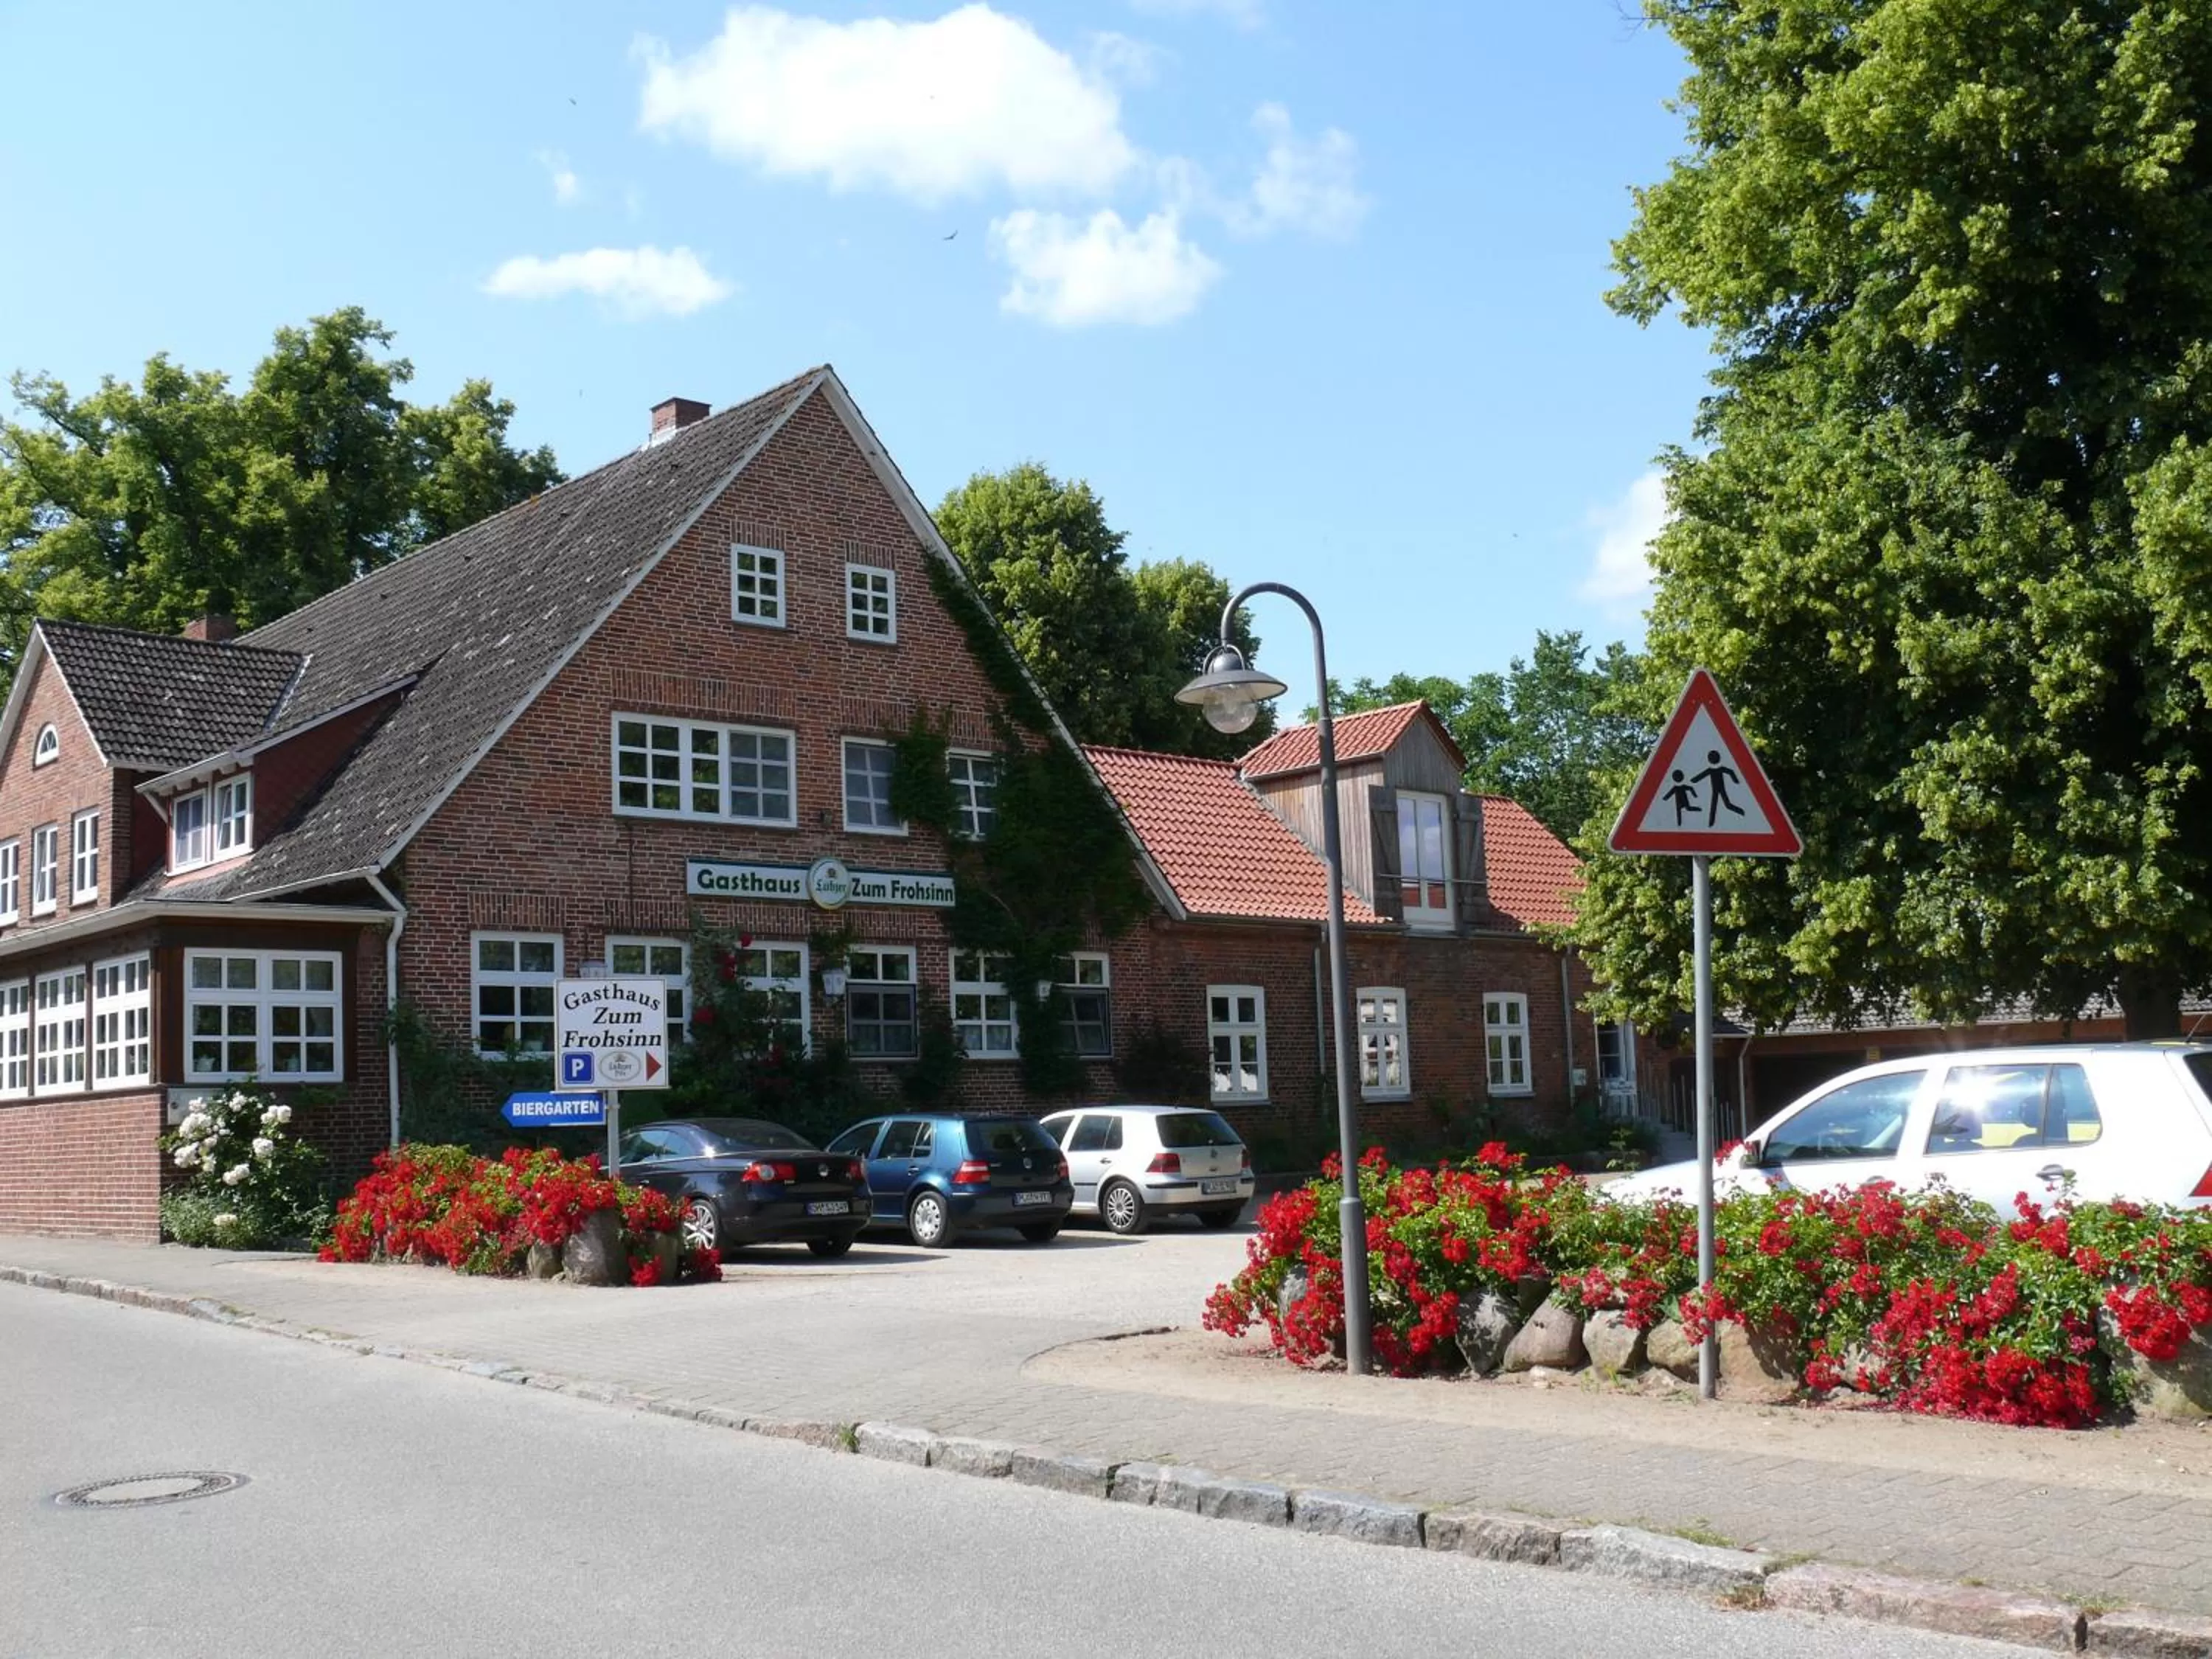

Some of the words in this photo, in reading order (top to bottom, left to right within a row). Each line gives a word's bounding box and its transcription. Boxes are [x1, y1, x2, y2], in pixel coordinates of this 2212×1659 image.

[697, 869, 800, 894] Gasthaus
[852, 878, 886, 897] Zum
[891, 880, 954, 902] Frohsinn
[564, 984, 661, 1011] Gasthaus
[593, 1007, 642, 1024] Zum
[563, 1029, 661, 1047] Frohsinn
[571, 1058, 585, 1077] P
[512, 1100, 599, 1116] BIERGARTEN
